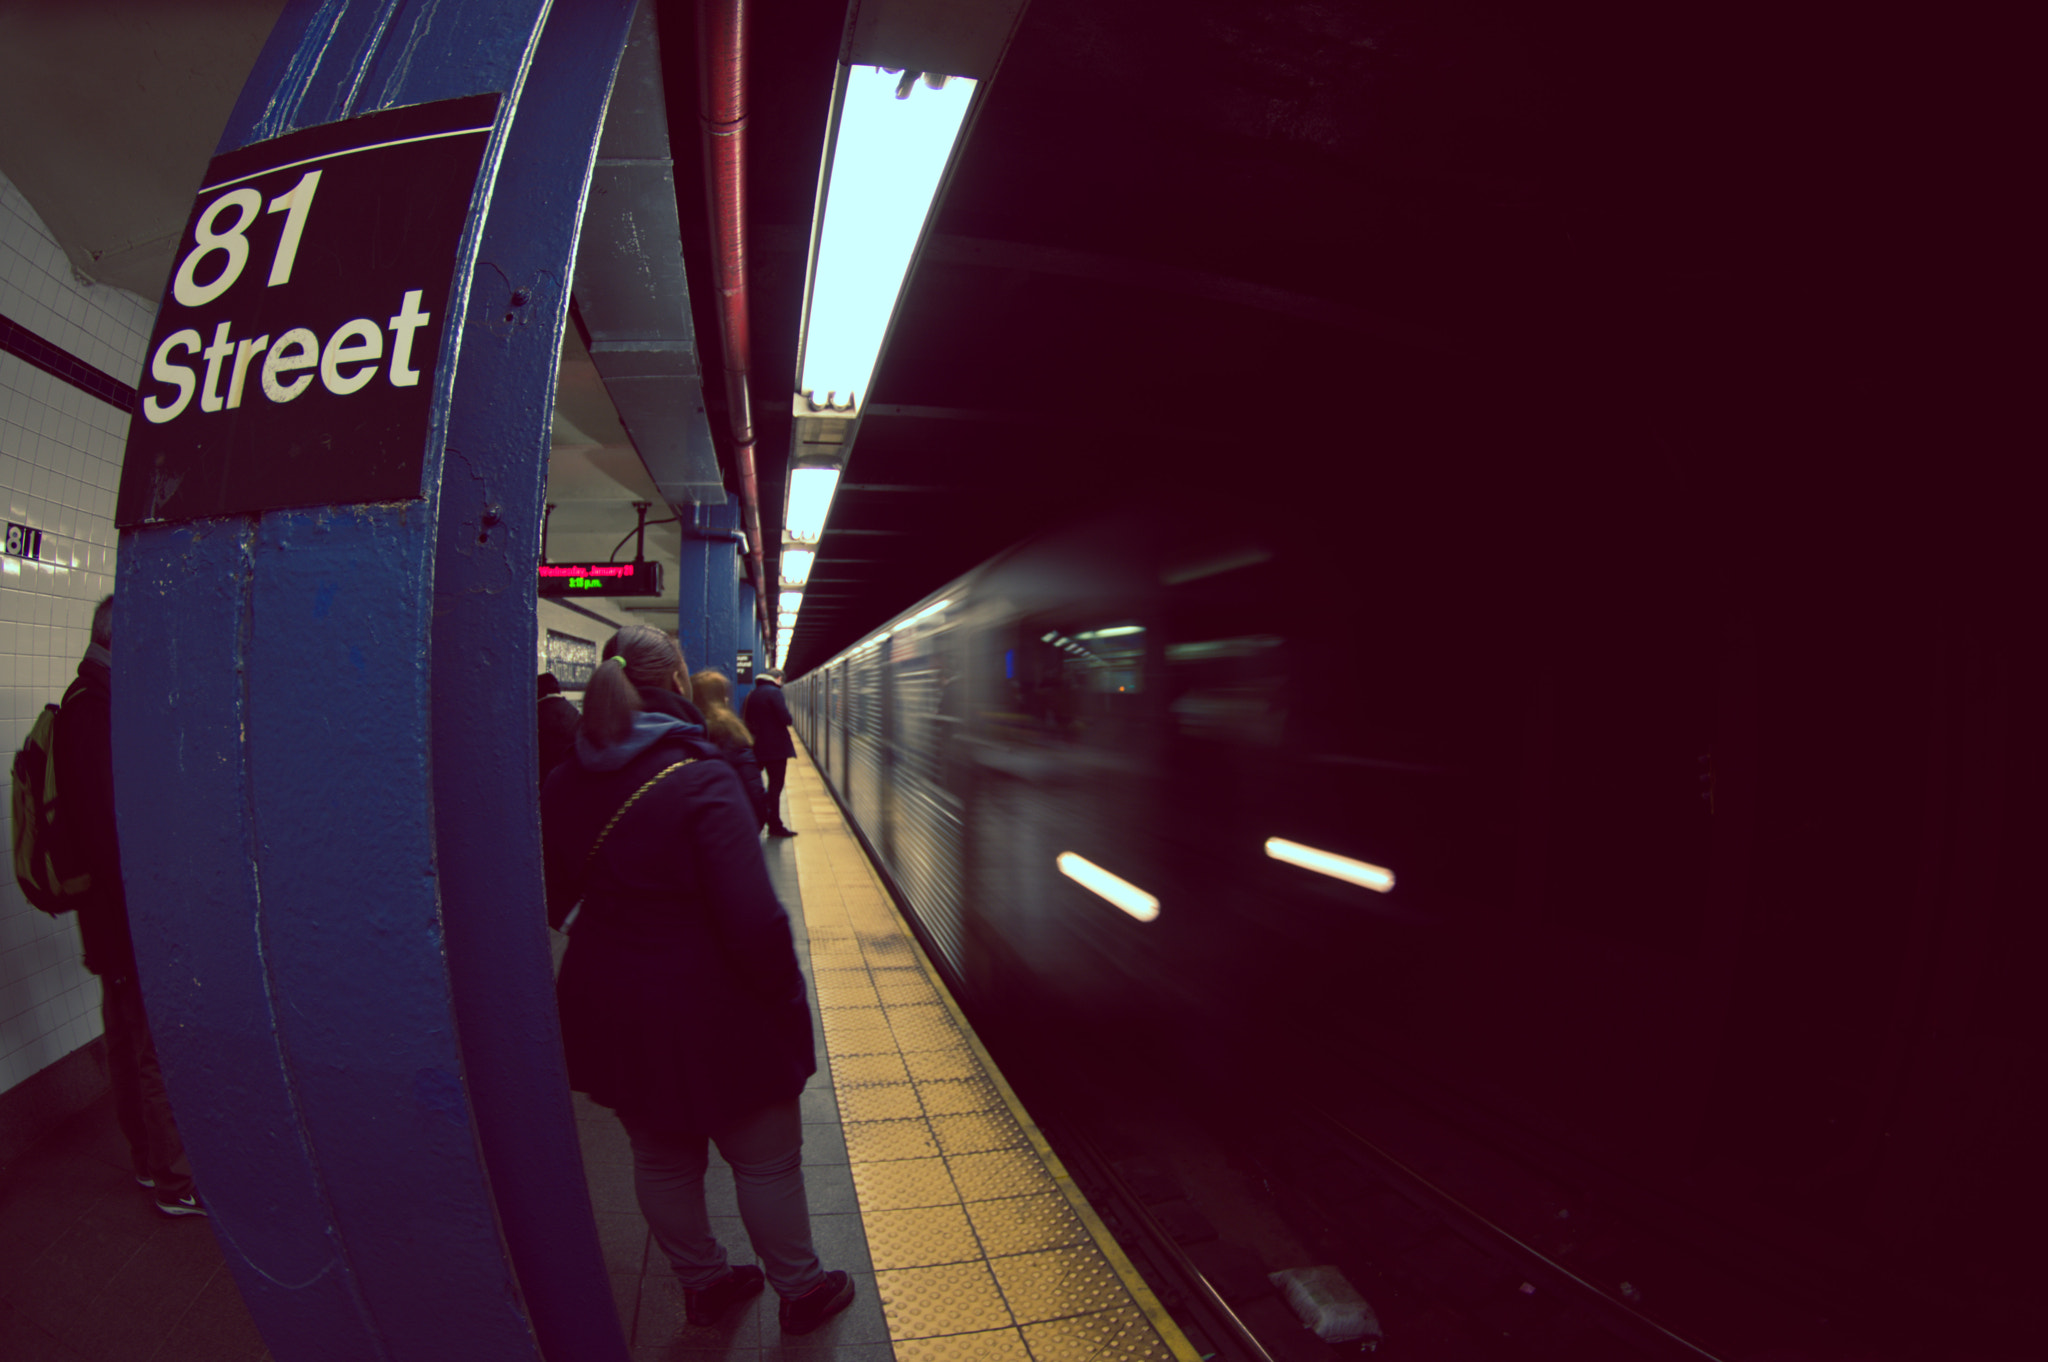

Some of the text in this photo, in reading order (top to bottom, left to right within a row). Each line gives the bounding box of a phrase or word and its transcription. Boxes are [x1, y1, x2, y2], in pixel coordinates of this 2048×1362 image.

[173, 168, 324, 308] 81
[143, 289, 431, 424] Street
[7, 526, 36, 558] 81
